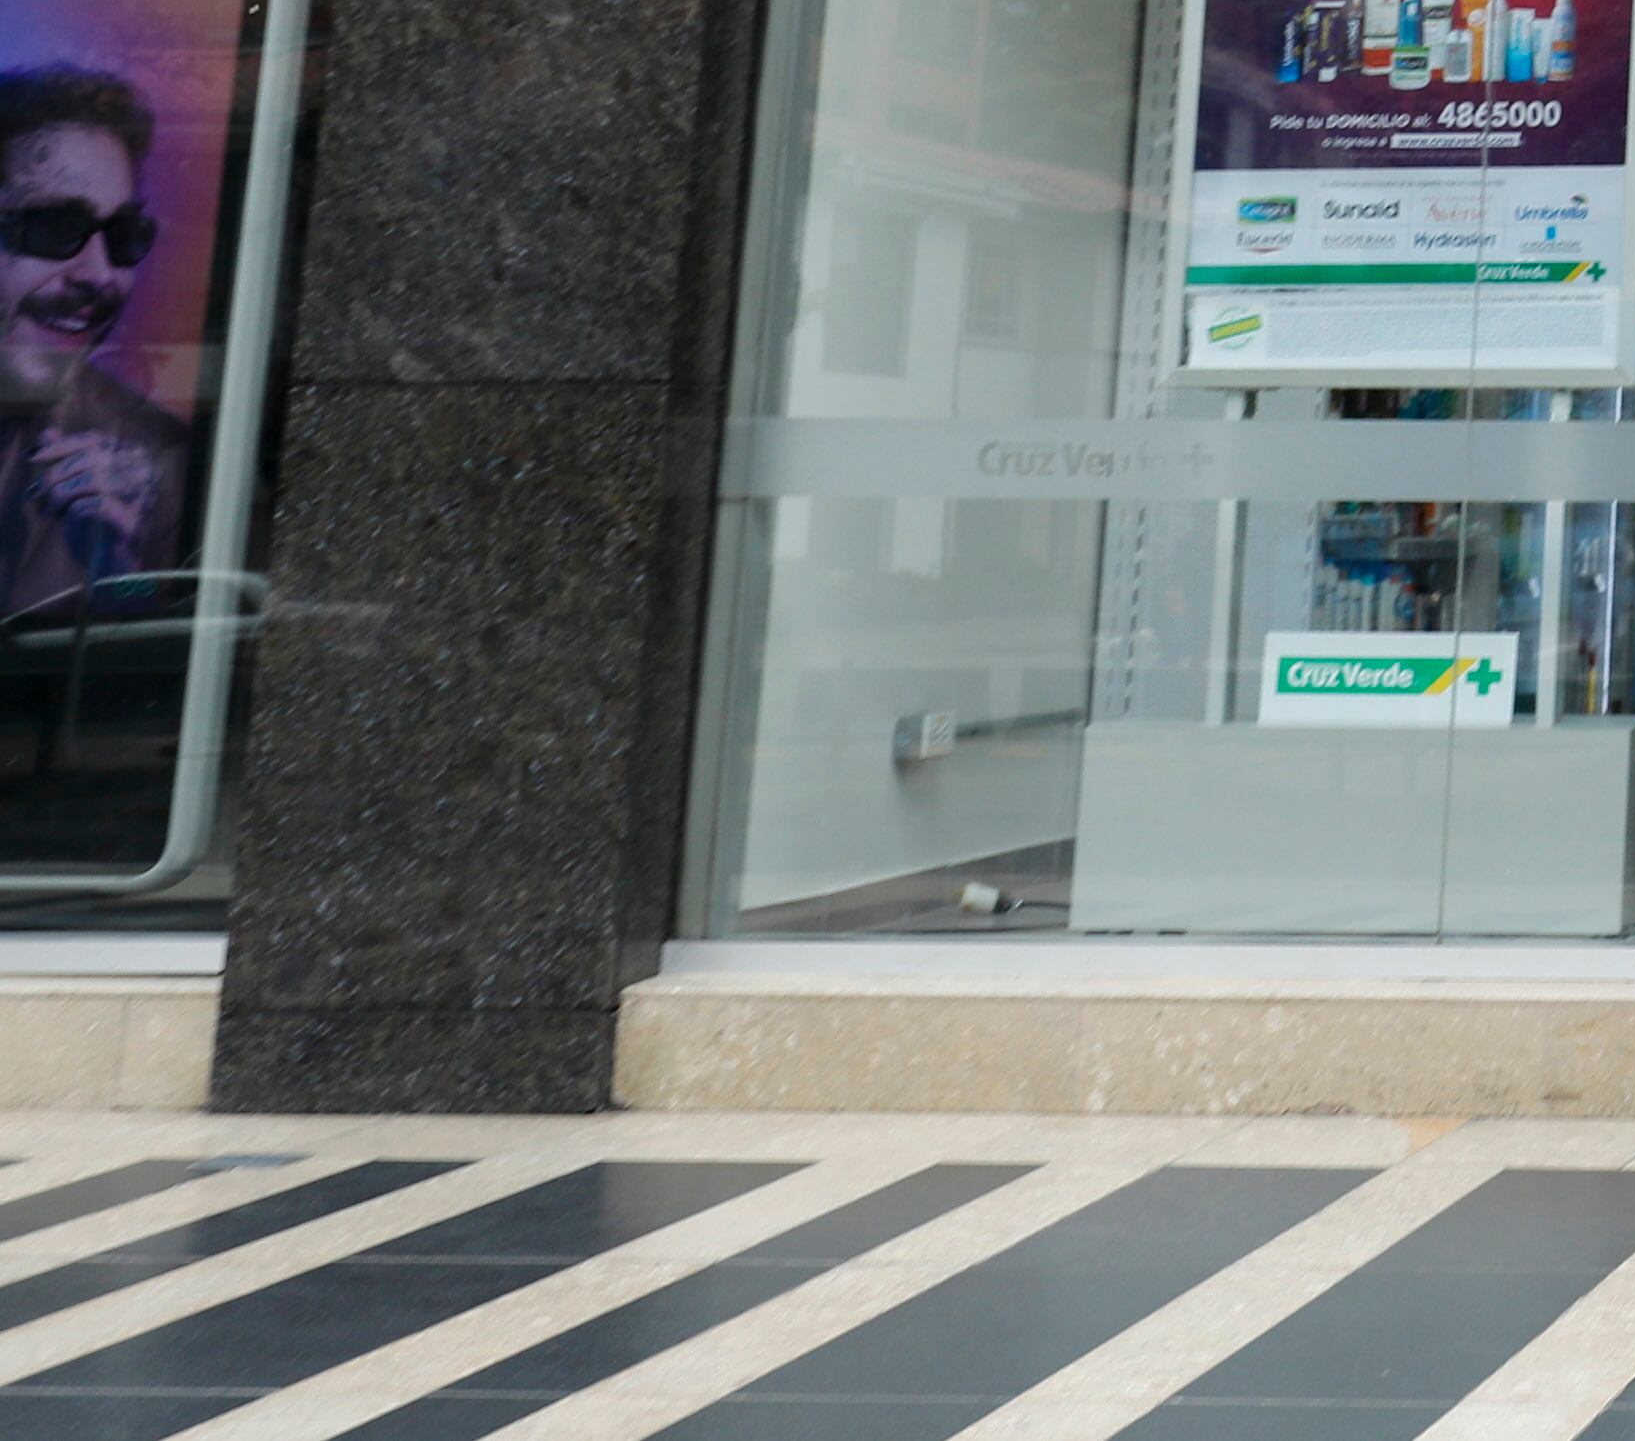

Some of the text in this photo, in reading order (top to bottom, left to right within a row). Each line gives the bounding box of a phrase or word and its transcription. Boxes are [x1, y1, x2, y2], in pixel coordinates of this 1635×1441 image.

[1437, 100, 1563, 130] 4865000
[1287, 661, 1415, 689] Cruz Verde
